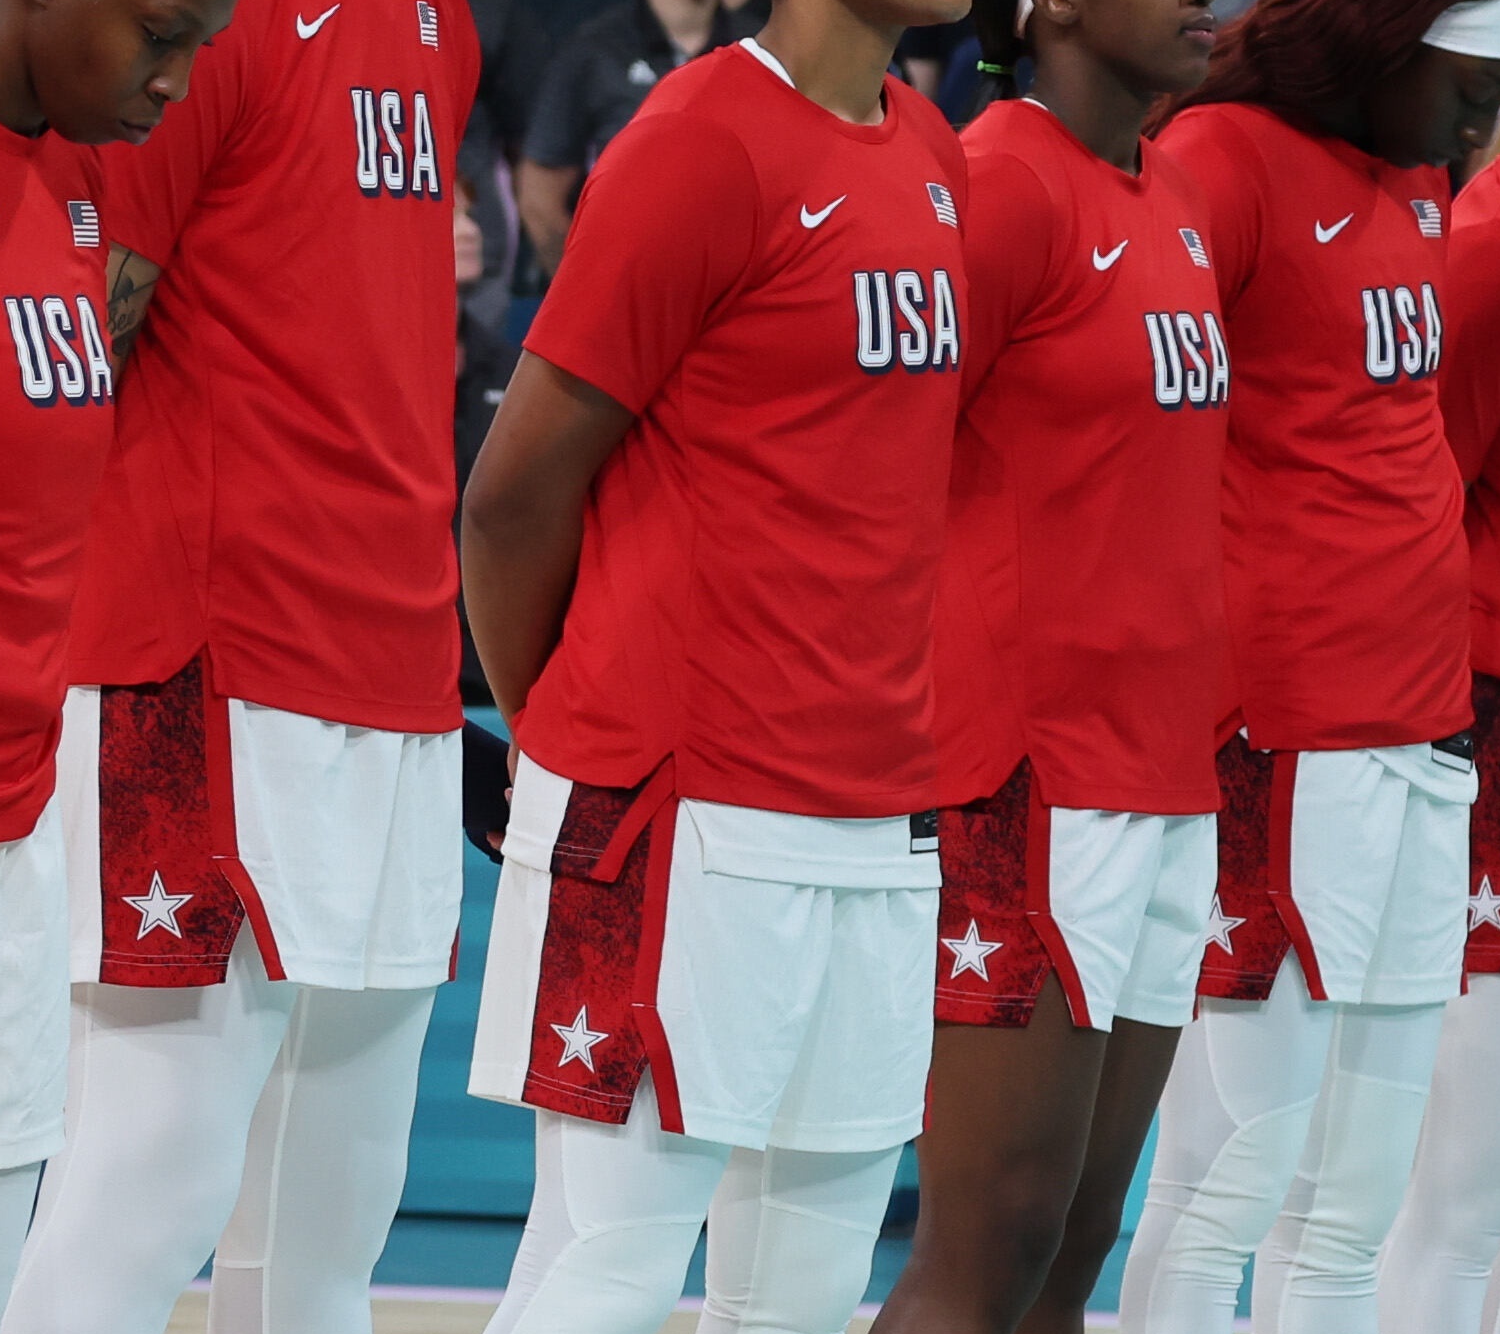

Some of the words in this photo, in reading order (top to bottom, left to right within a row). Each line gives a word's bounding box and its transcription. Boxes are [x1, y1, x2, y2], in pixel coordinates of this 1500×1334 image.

[350, 87, 442, 201] USA
[4, 294, 115, 408] USA
[852, 269, 961, 374] USA
[1145, 311, 1231, 410] USA
[1362, 283, 1442, 383] USA
